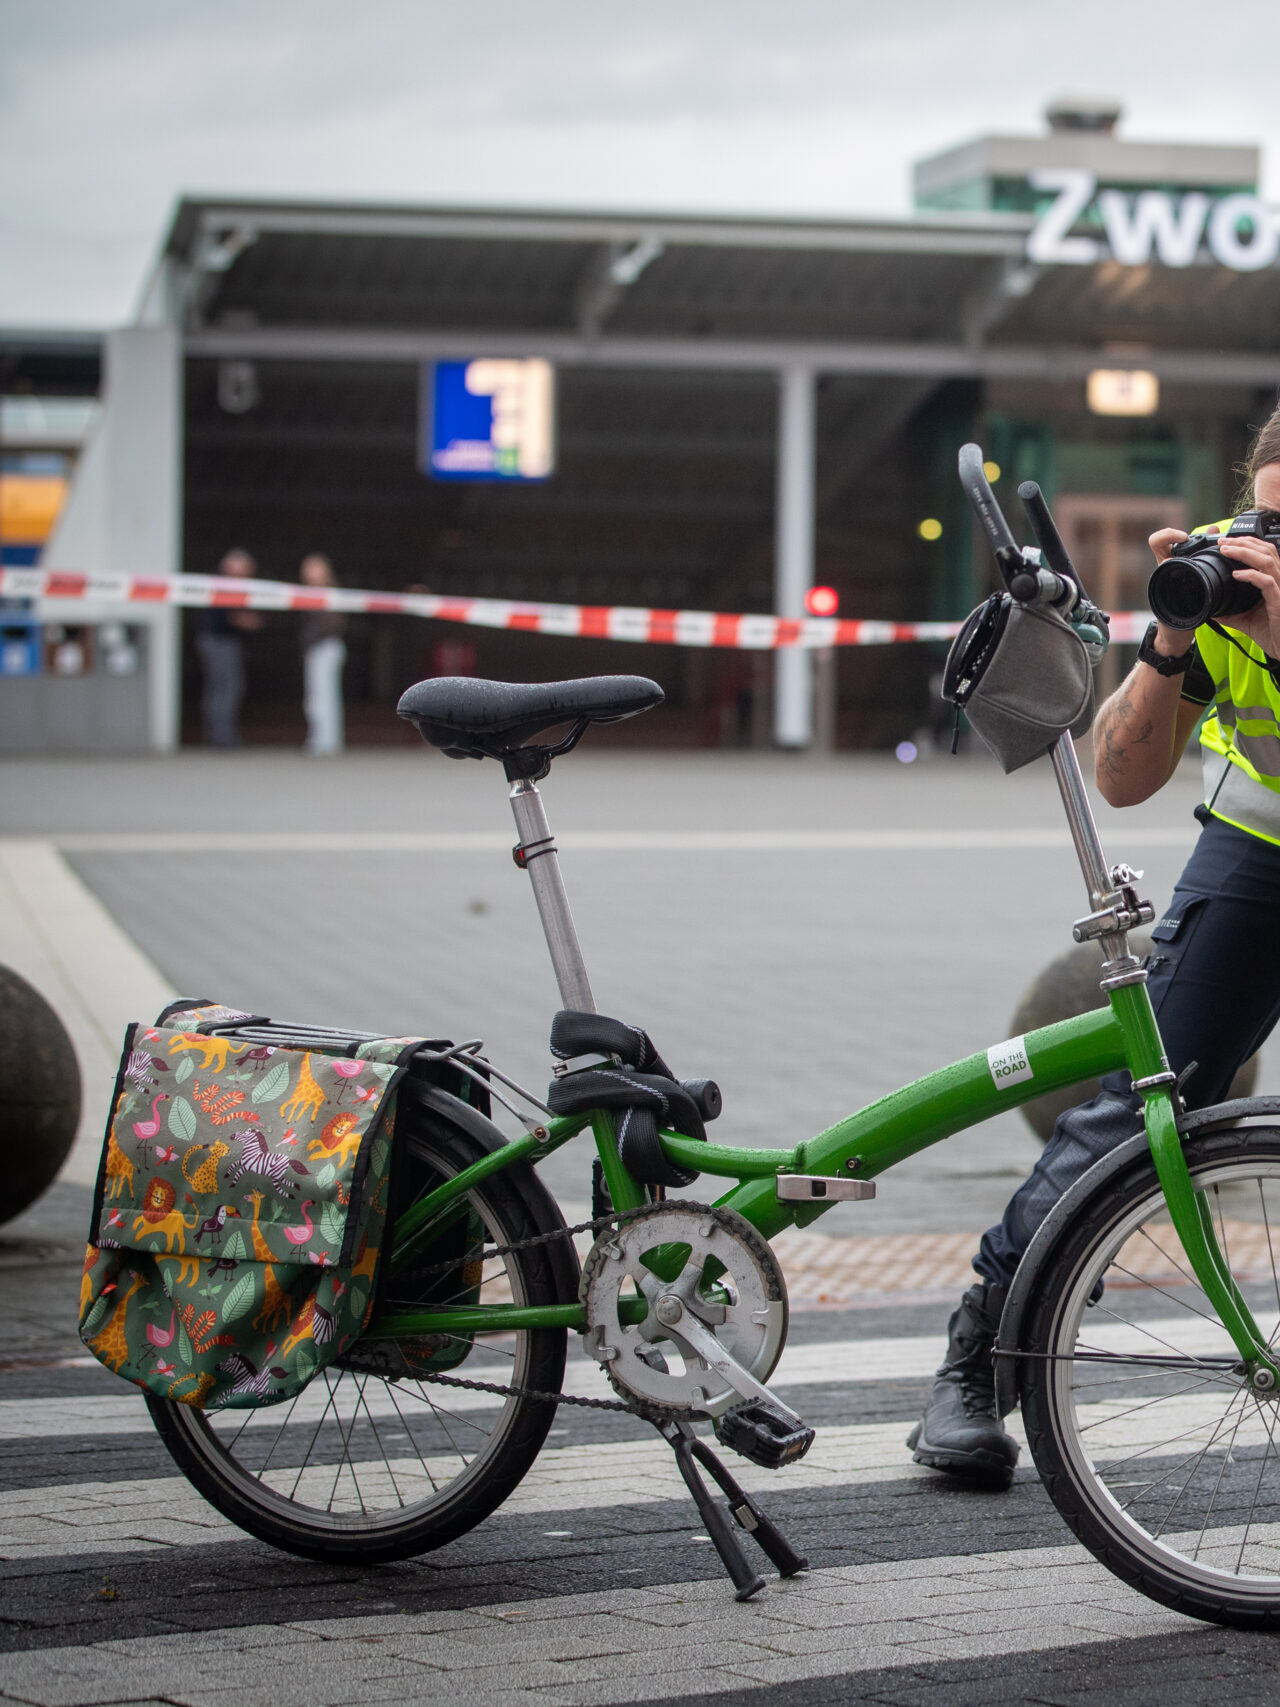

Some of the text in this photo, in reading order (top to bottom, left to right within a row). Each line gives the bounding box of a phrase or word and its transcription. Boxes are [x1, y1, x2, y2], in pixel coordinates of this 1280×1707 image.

[992, 1051, 1024, 1069] ON THE
[995, 1060, 1027, 1079] ROAD
